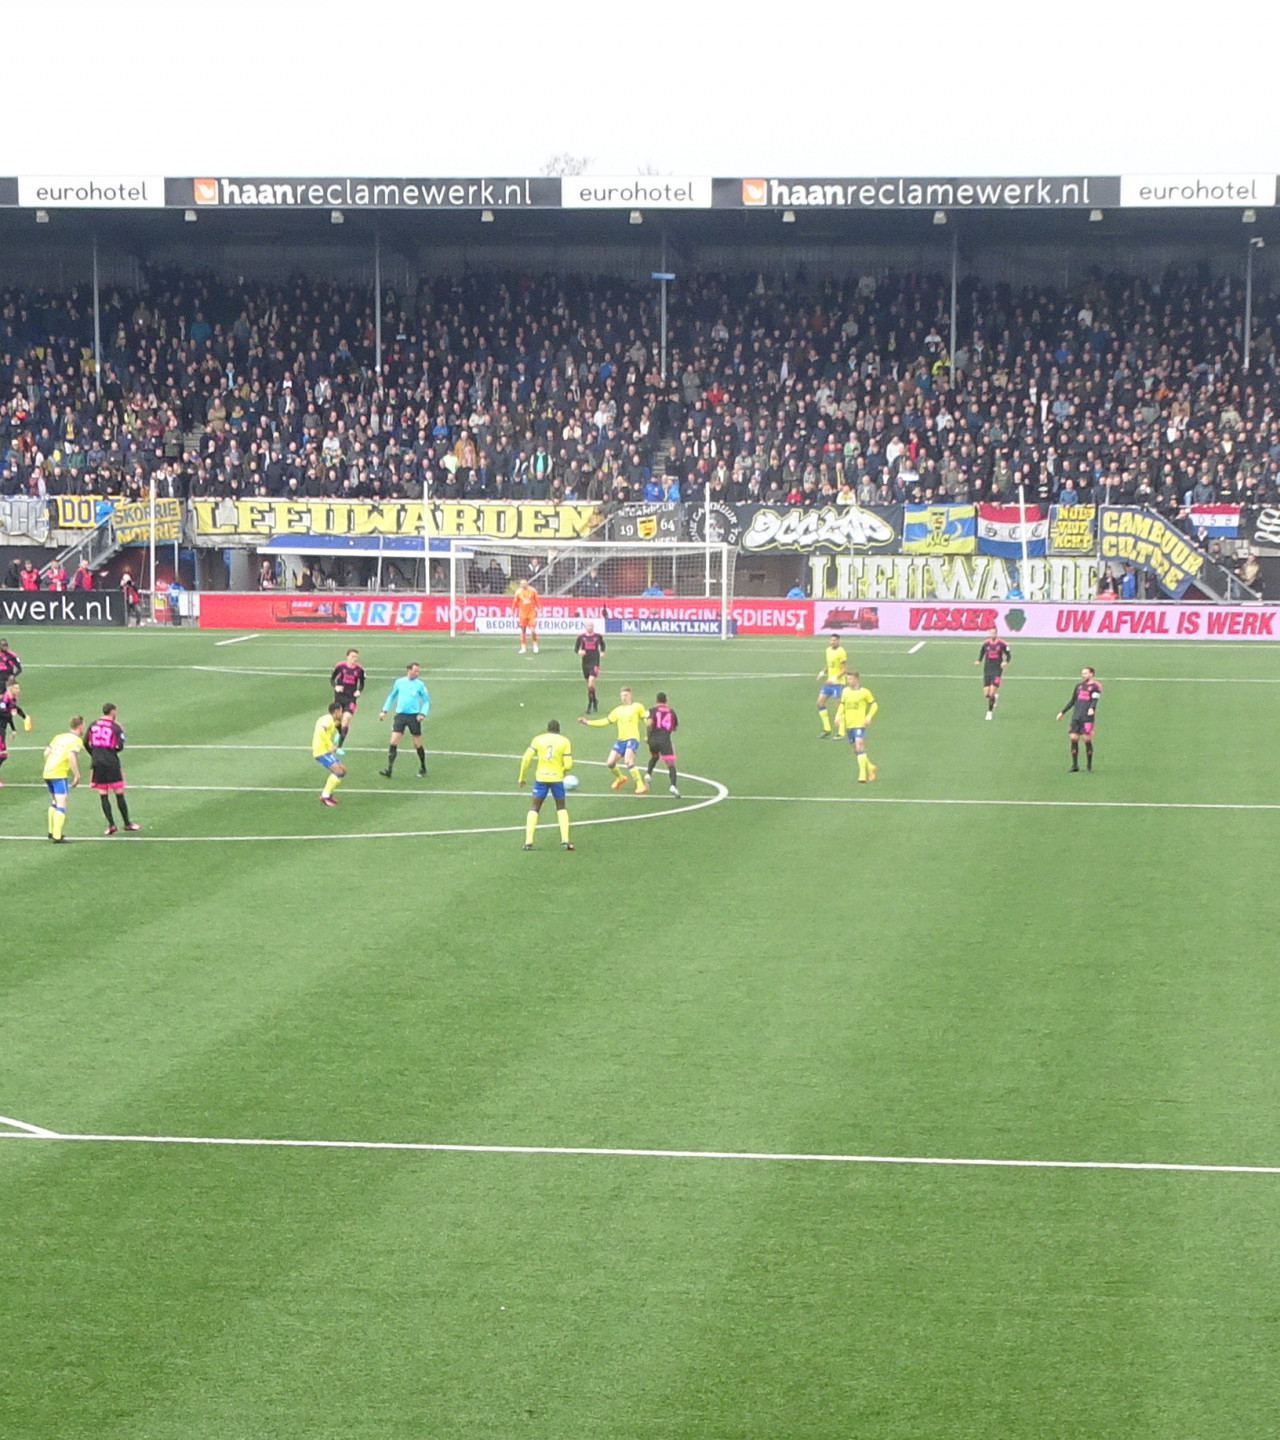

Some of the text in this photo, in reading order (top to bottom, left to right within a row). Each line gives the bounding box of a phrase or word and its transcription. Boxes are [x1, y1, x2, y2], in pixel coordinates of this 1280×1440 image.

[36, 181, 148, 201] eurohotel
[222, 178, 531, 206] haanreclamewerk.nl
[579, 182, 694, 202] eurohotel
[771, 178, 1089, 205] haanreclamewerk.nl
[1139, 181, 1257, 201] eurohotel
[194, 501, 595, 538] LEEUWARDEN
[1102, 511, 1204, 576] CAMBUUR
[346, 601, 422, 625] NRD
[908, 608, 998, 630] VISSER
[1055, 609, 1096, 633] UW
[1098, 610, 1169, 634] AFVAL
[1177, 611, 1201, 634] IS
[1207, 612, 1277, 635] WERK
[640, 620, 719, 633] MARKTLINK
[655, 711, 673, 730] 14
[91, 725, 113, 747] 29
